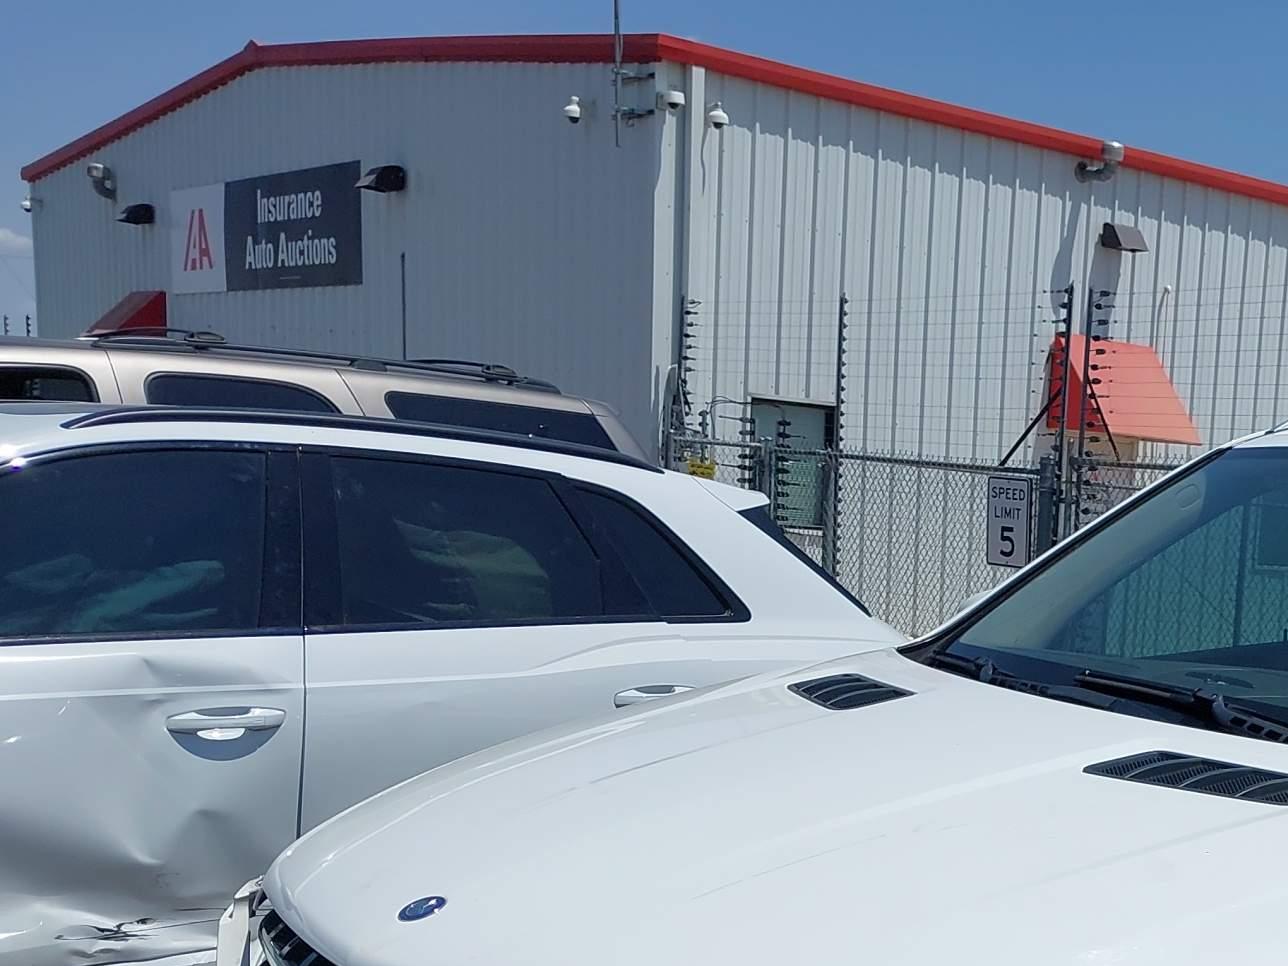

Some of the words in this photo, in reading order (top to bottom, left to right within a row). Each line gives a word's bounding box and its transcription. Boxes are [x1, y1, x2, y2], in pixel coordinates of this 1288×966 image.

[257, 189, 322, 224] Insurance
[246, 235, 275, 269] Auto
[277, 229, 337, 267] Auctions
[991, 486, 1026, 501] SPEED
[994, 505, 1022, 520] LIMIT
[1000, 526, 1014, 557] 5
